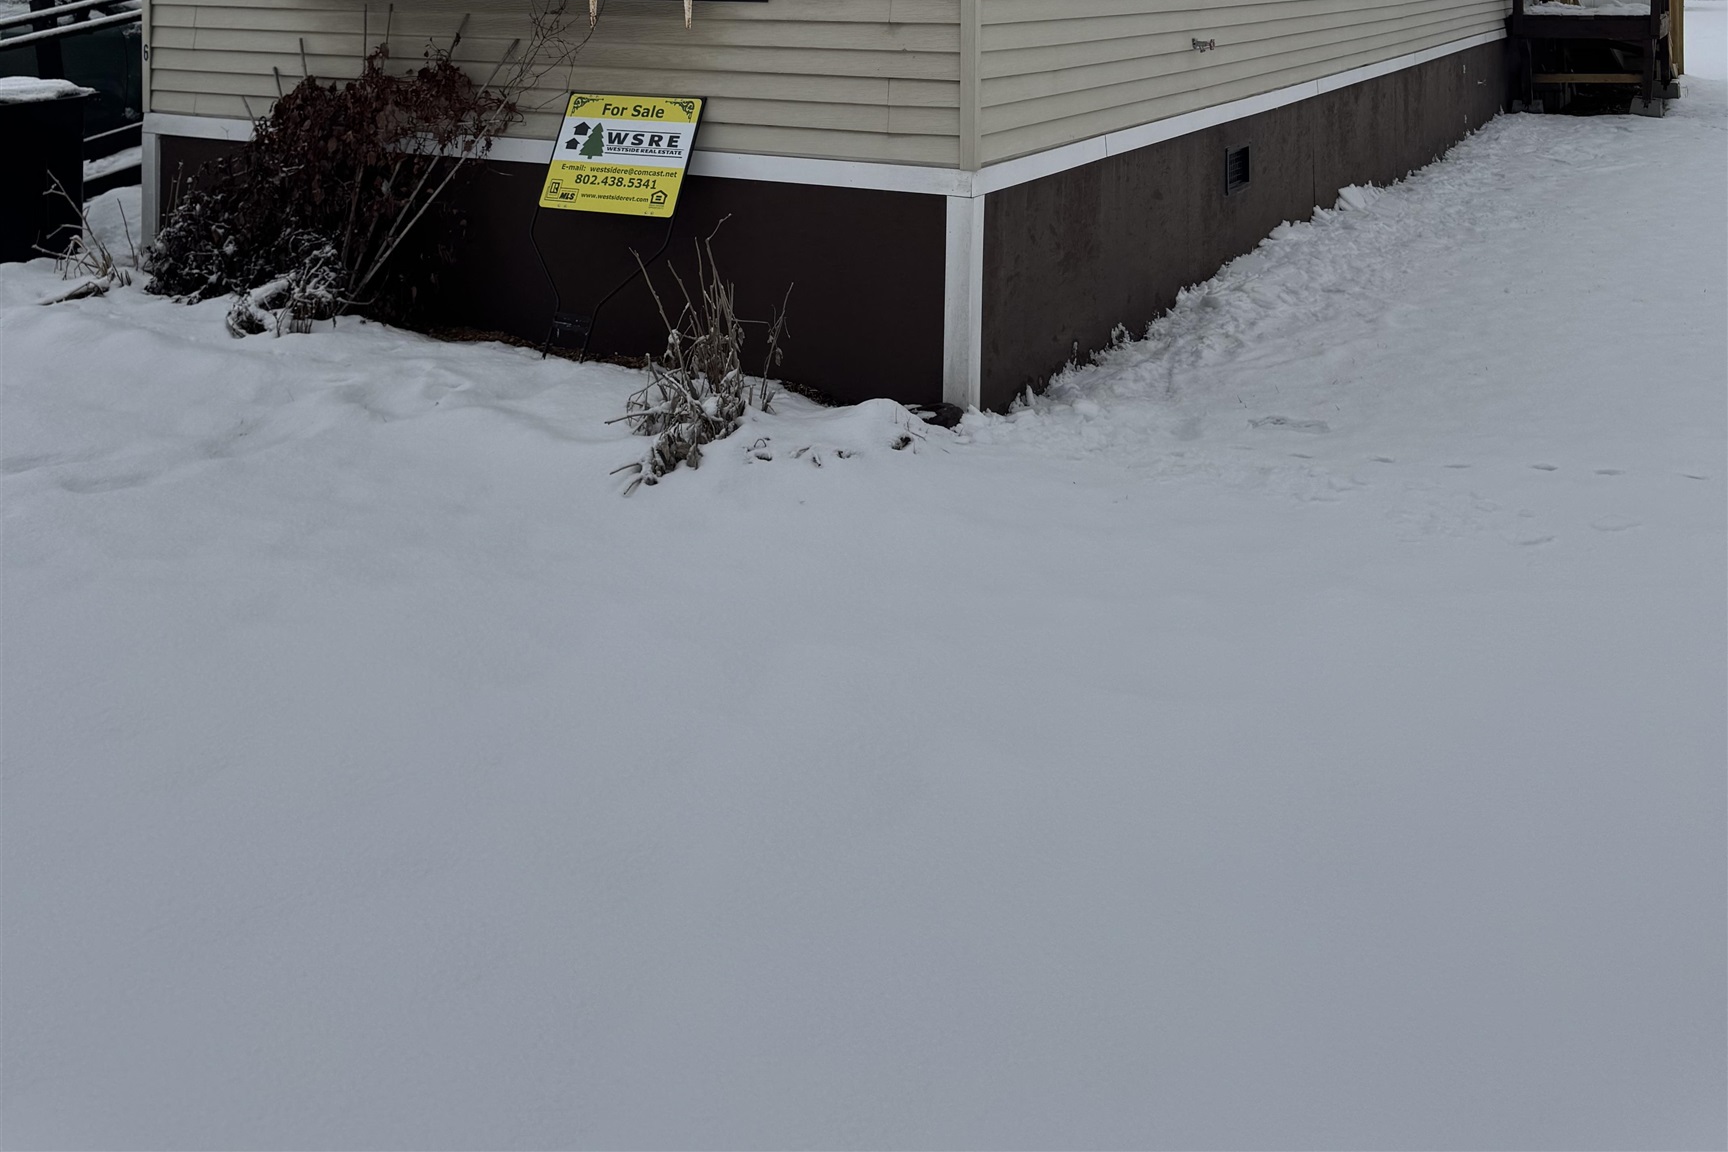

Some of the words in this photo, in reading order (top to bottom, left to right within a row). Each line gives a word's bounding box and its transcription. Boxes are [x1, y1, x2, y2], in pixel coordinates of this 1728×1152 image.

[143, 44, 149, 61] 6
[602, 104, 628, 116] For
[631, 105, 664, 118] Sale
[608, 132, 681, 148] WSRE
[561, 164, 586, 172] E-mail:
[590, 166, 677, 178] westsidere@comcast.net
[575, 174, 657, 189] 802.438.5341
[559, 192, 576, 200] MLS
[581, 193, 648, 202] www.westsiderevt.com
